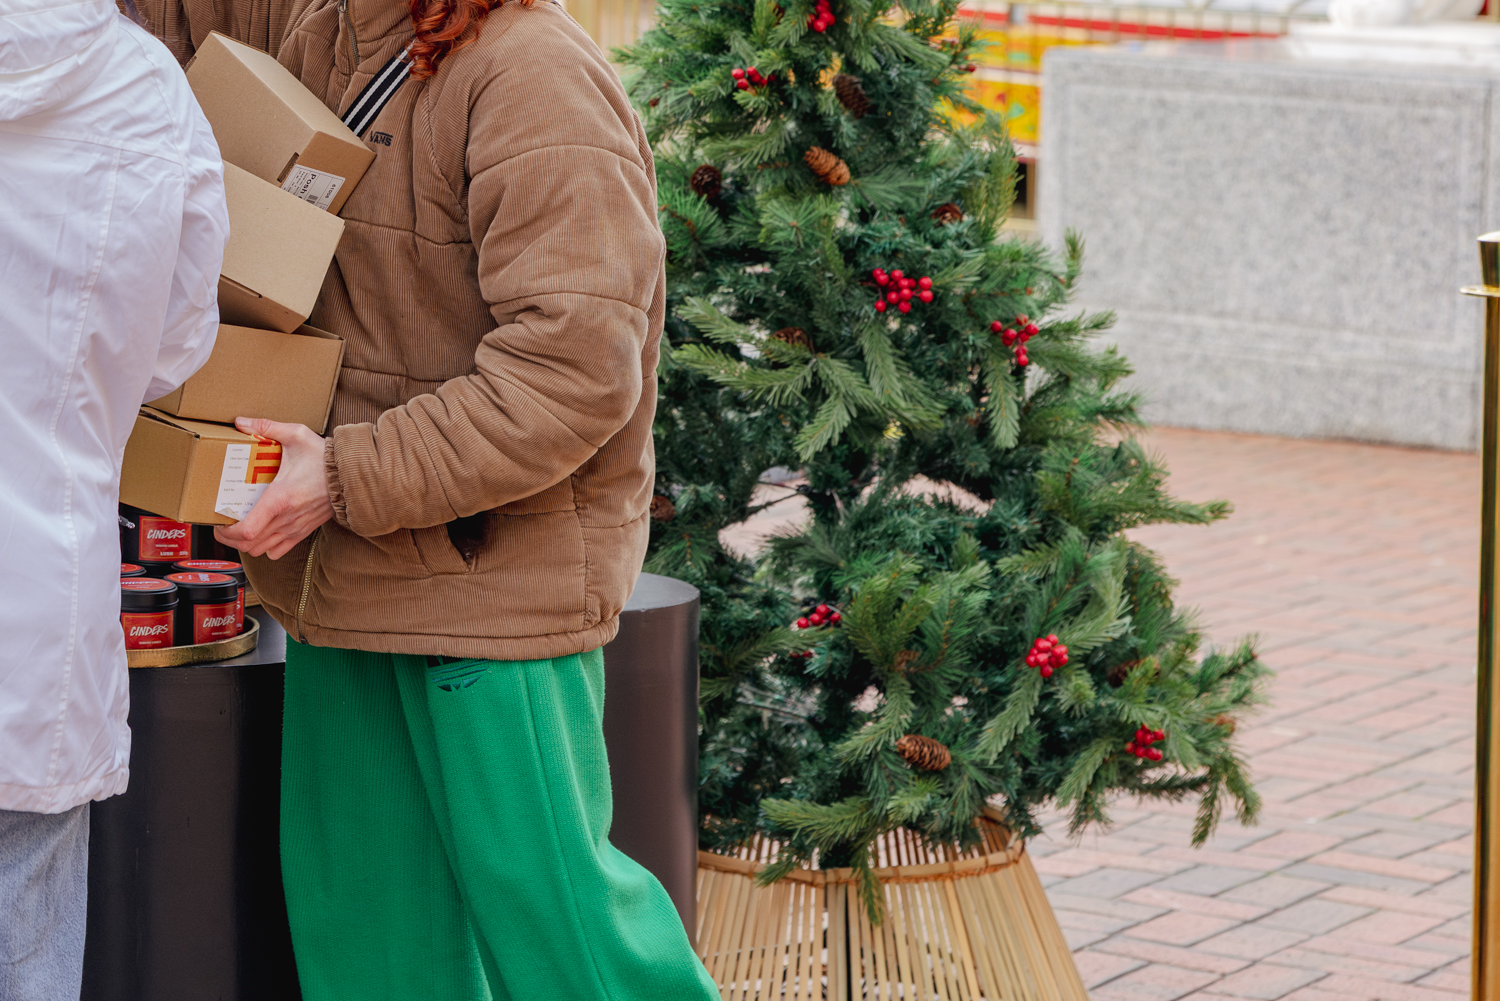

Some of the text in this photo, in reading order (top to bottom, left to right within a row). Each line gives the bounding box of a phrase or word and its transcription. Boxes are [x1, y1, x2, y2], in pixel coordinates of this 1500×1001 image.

[370, 131, 393, 147] VANS
[300, 173, 317, 194] Posh
[147, 529, 186, 540] CINDERS
[203, 614, 235, 628] CINDERS
[130, 624, 168, 637] CINDERS
